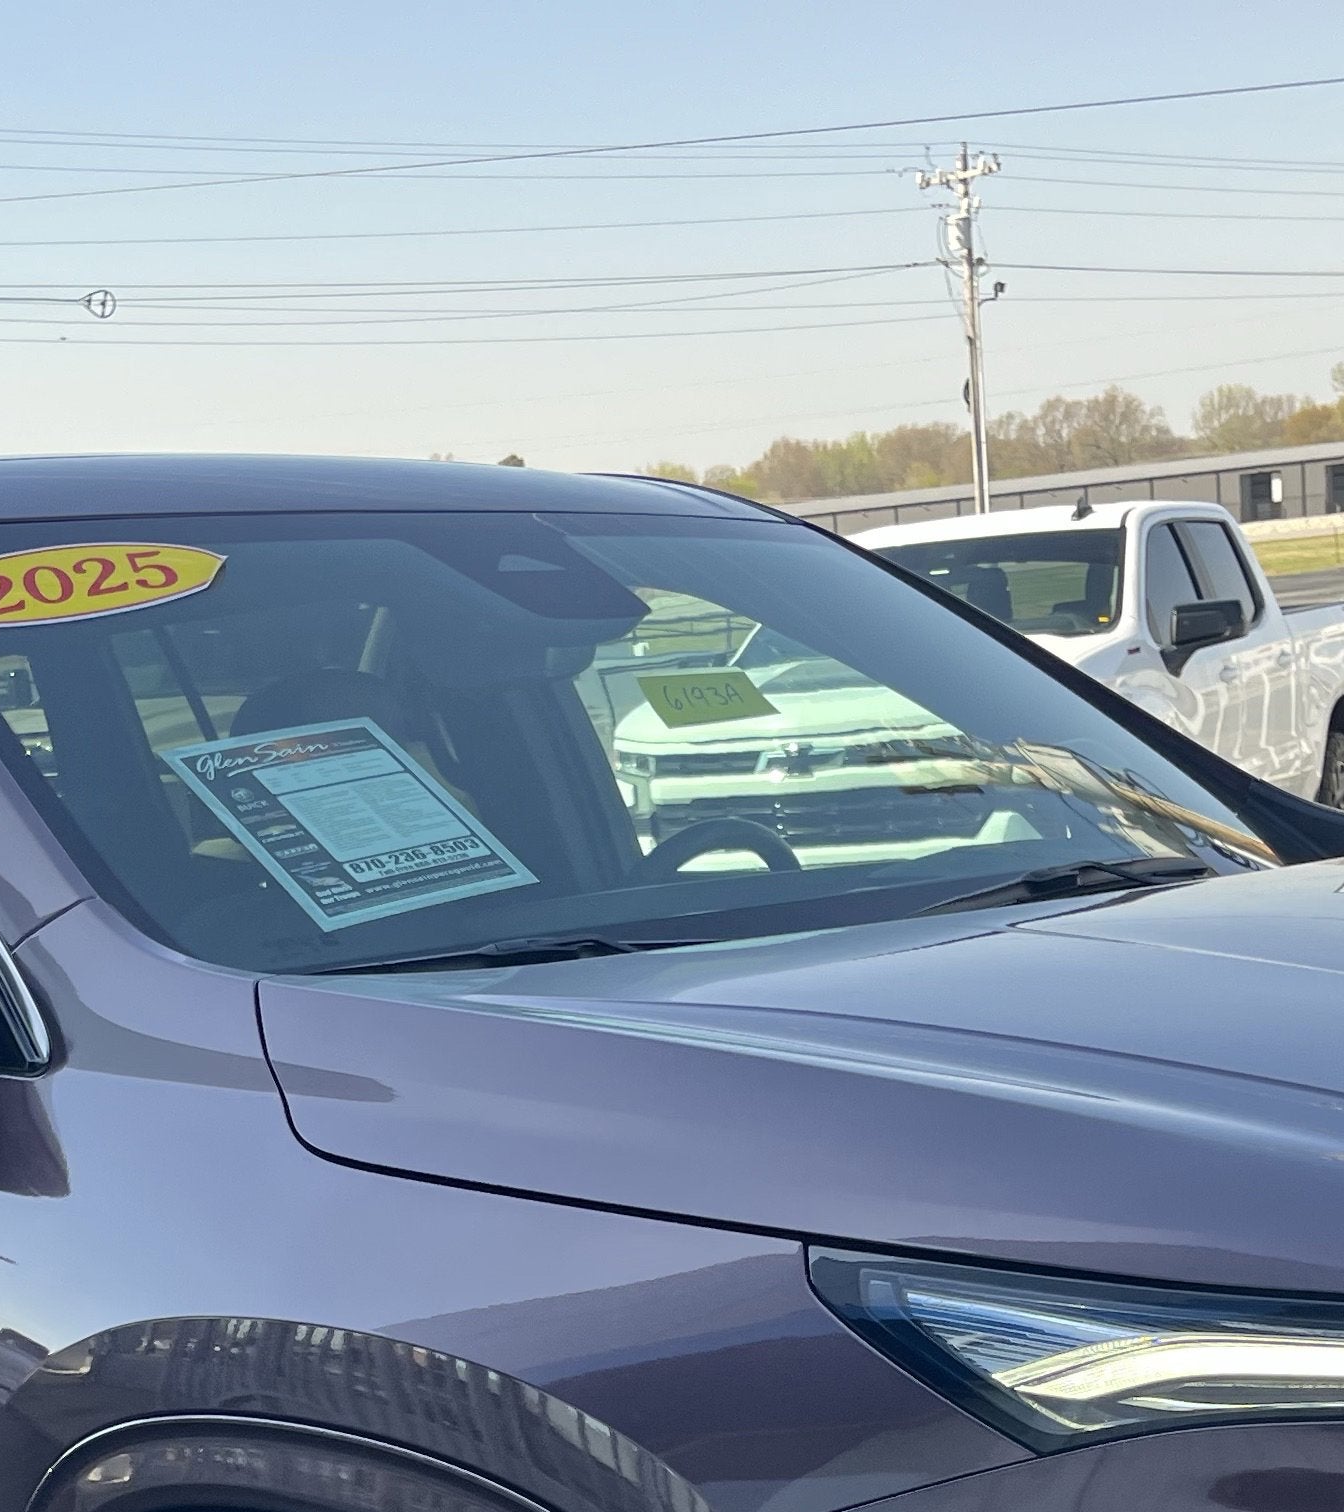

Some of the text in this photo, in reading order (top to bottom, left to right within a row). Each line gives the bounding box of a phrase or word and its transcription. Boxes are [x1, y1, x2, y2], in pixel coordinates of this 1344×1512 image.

[196, 752, 256, 781] Glen
[253, 741, 329, 763] Sain
[348, 837, 481, 875] 870-236-8503
